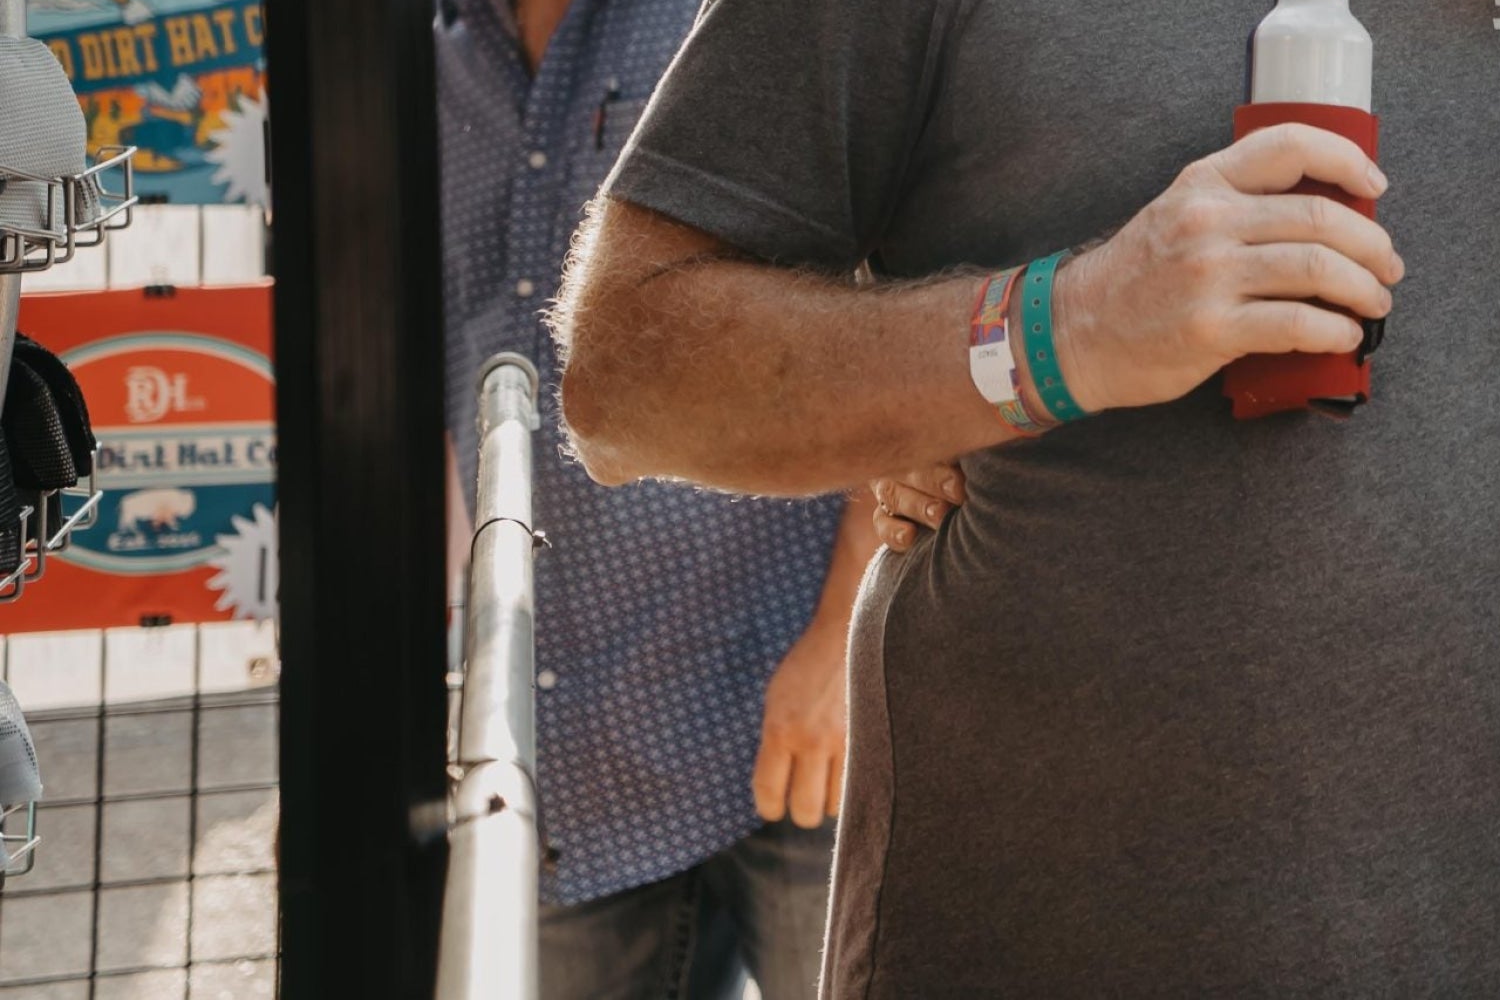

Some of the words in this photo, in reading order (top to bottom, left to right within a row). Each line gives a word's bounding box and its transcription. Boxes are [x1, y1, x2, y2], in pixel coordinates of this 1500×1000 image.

[78, 23, 158, 81] DIRT
[165, 9, 237, 67] HAT
[243, 3, 267, 47] C
[178, 442, 235, 466] Hat
